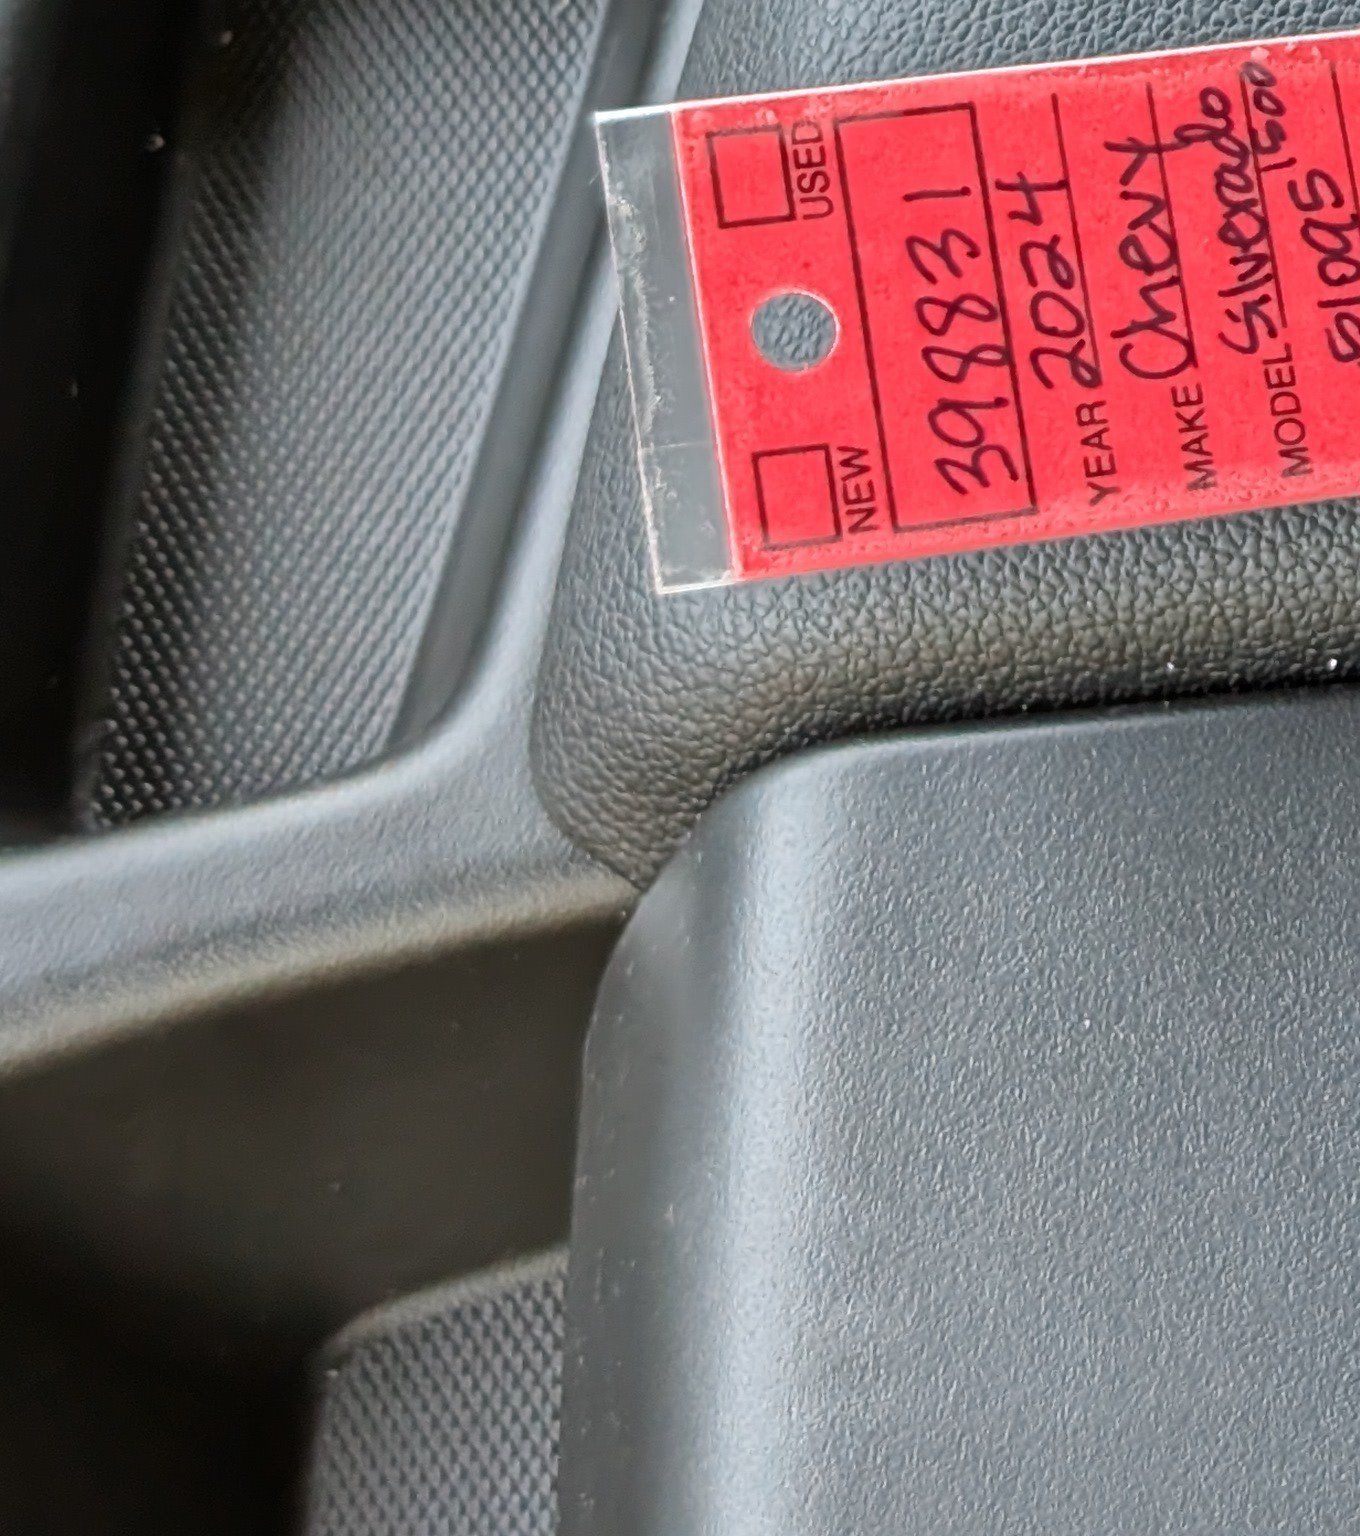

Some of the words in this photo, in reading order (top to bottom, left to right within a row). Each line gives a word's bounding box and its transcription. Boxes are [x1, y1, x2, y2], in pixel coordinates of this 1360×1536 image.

[791, 118, 835, 221] USED
[1240, 61, 1298, 174] 1500
[994, 170, 1103, 390] 2024
[1104, 135, 1199, 380] Chevy
[1173, 86, 1285, 356] Silverado
[904, 185, 1019, 495] 398831
[1075, 399, 1121, 506] YEAR
[1170, 382, 1217, 492] MAKE
[1263, 341, 1314, 479] MODEL
[838, 444, 878, 533] NEW
